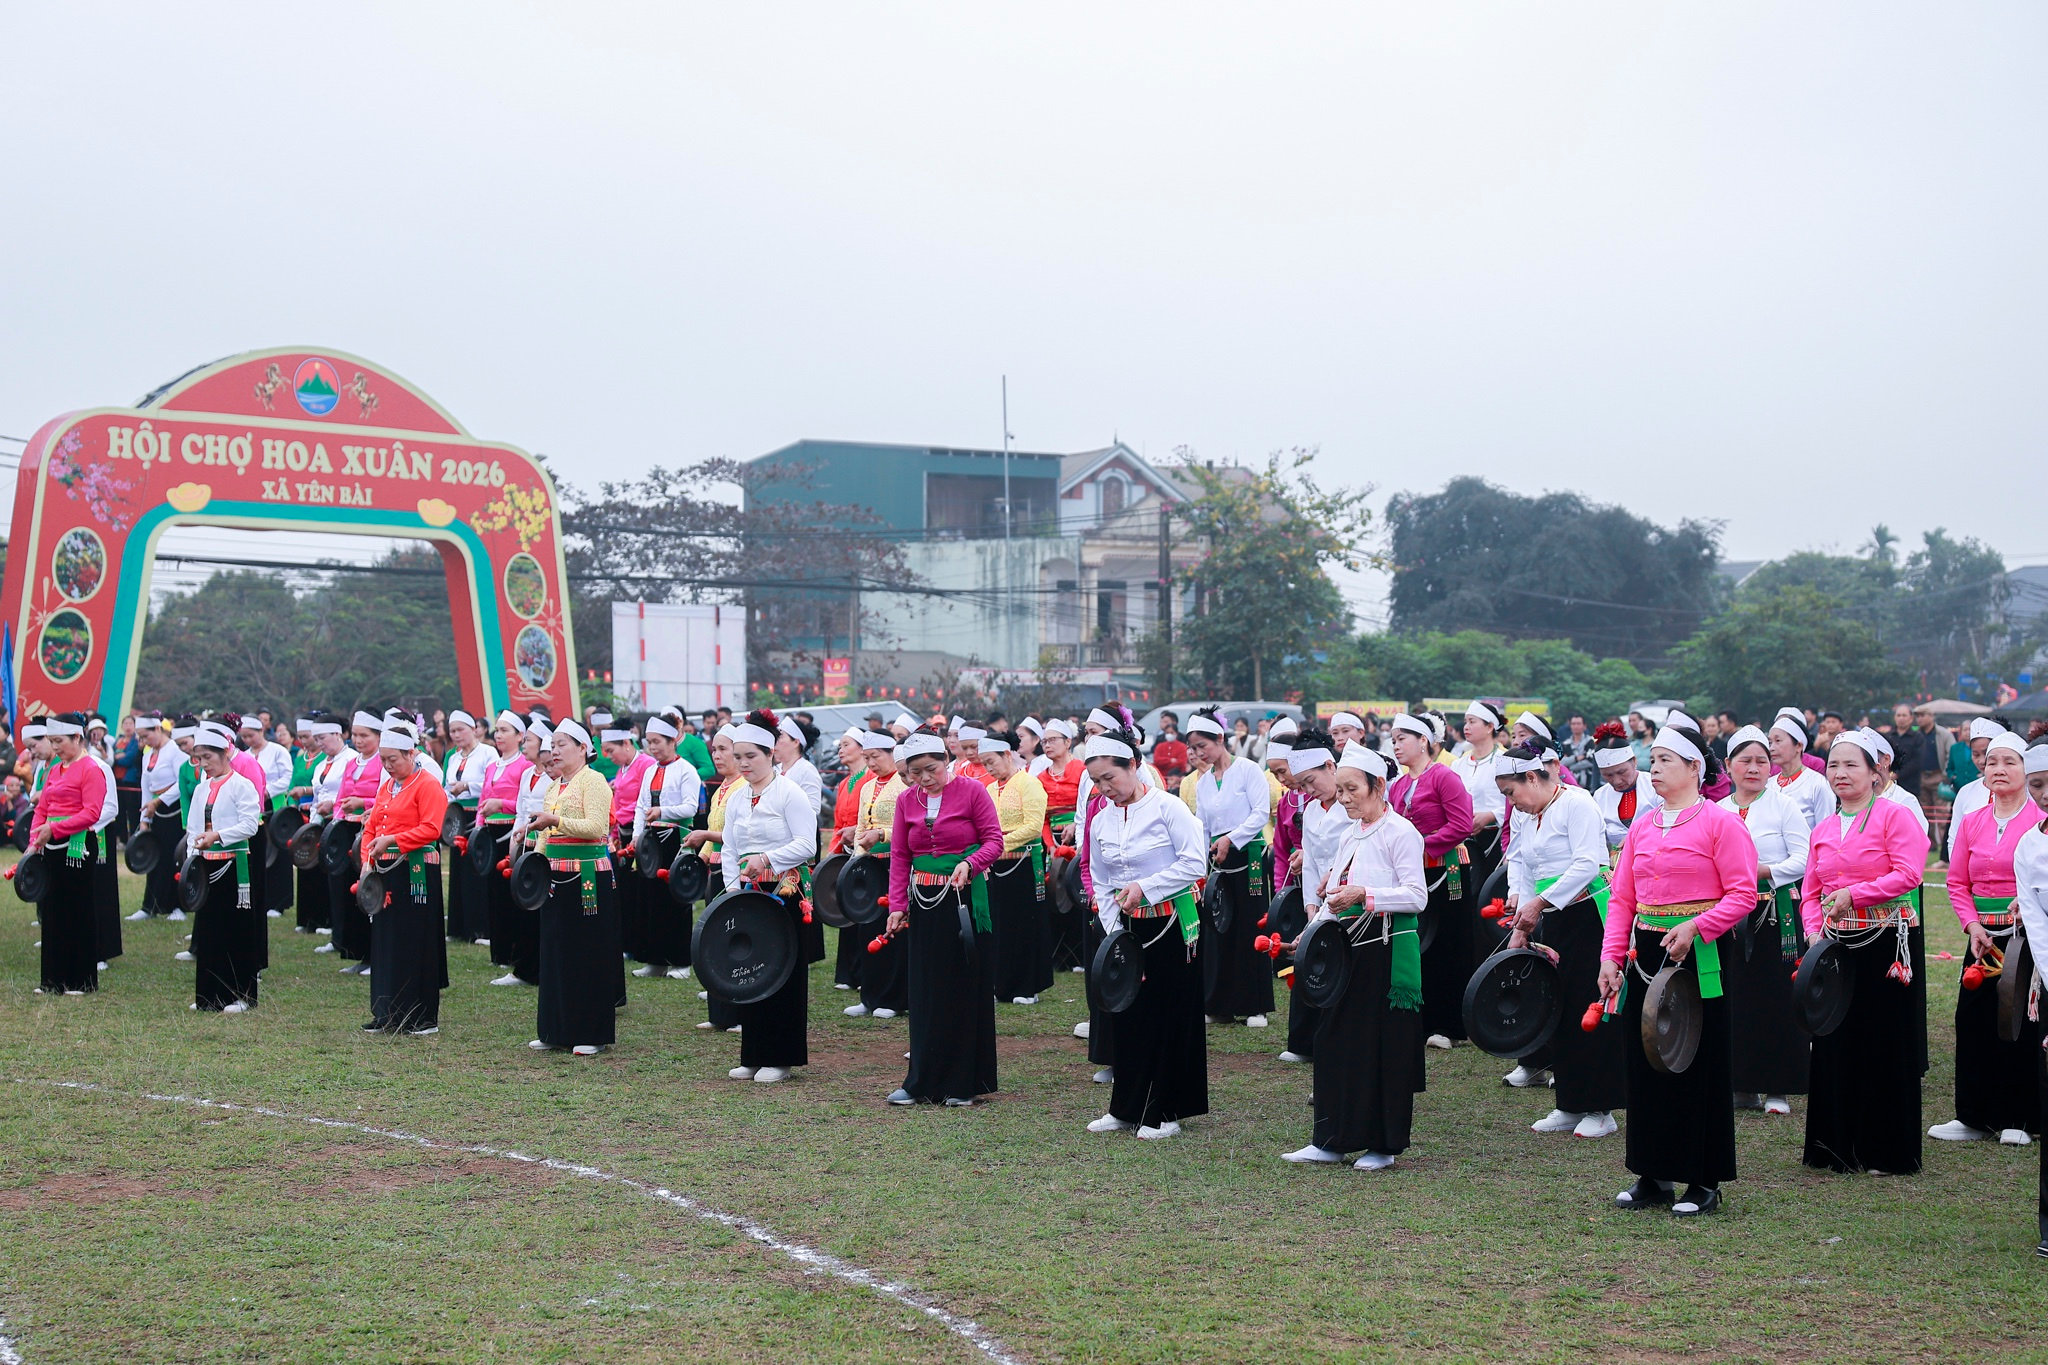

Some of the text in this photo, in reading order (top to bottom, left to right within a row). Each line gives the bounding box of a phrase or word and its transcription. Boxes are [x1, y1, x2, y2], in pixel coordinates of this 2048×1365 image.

[107, 420, 506, 488] HỘI CHỢ HOA XUÂN 2026
[261, 477, 373, 506] XÃ YÊN BÀI
[724, 917, 736, 932] 11
